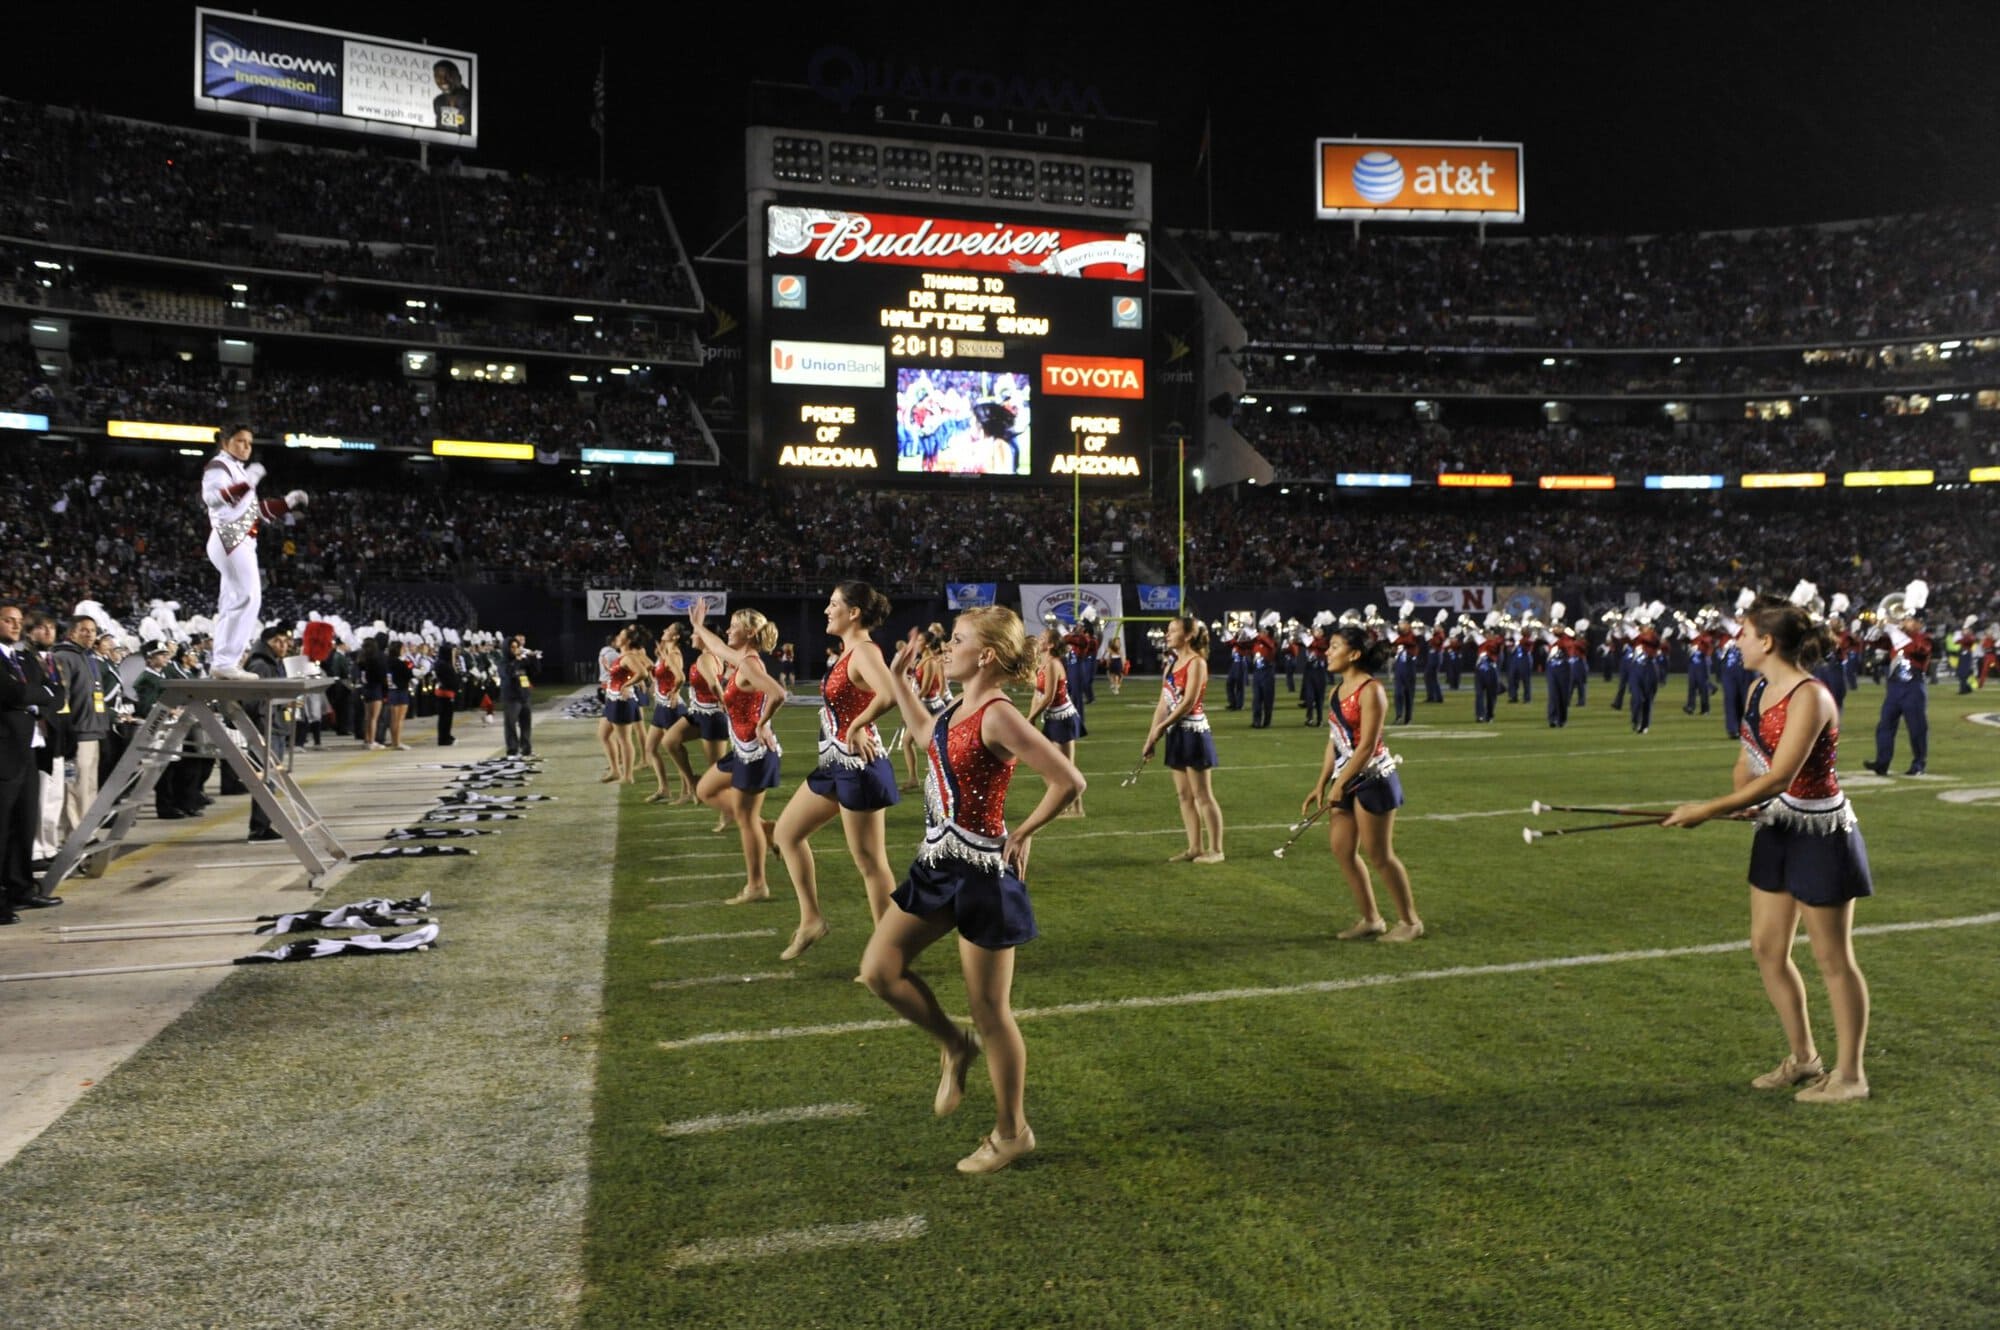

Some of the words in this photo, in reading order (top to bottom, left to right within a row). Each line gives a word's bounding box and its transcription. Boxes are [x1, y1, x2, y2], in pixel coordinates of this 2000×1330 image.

[208, 41, 336, 77] QUALCOMM
[350, 47, 431, 69] PALOMAR
[350, 62, 430, 84] POMERADO
[350, 75, 431, 97] HEALTH
[874, 105, 1084, 138] STADIUM
[1413, 160, 1497, 196] at&t
[802, 216, 1060, 263] Budweiser
[921, 273, 979, 292] THANKS
[983, 277, 1004, 293] TO
[909, 291, 937, 309] DR
[944, 293, 1016, 314] PEPPER
[880, 309, 986, 332] HALFTIME
[996, 316, 1049, 335] SHOW
[1046, 366, 1139, 389] TOYOTA
[801, 405, 856, 424] PRIDE
[1070, 416, 1121, 434] PRIDE
[816, 426, 841, 442] OF
[1083, 436, 1107, 452] OF
[779, 445, 878, 468] ARIZONA
[1050, 454, 1140, 476] ARIZONA
[600, 592, 627, 618] A
[1461, 588, 1485, 610] N
